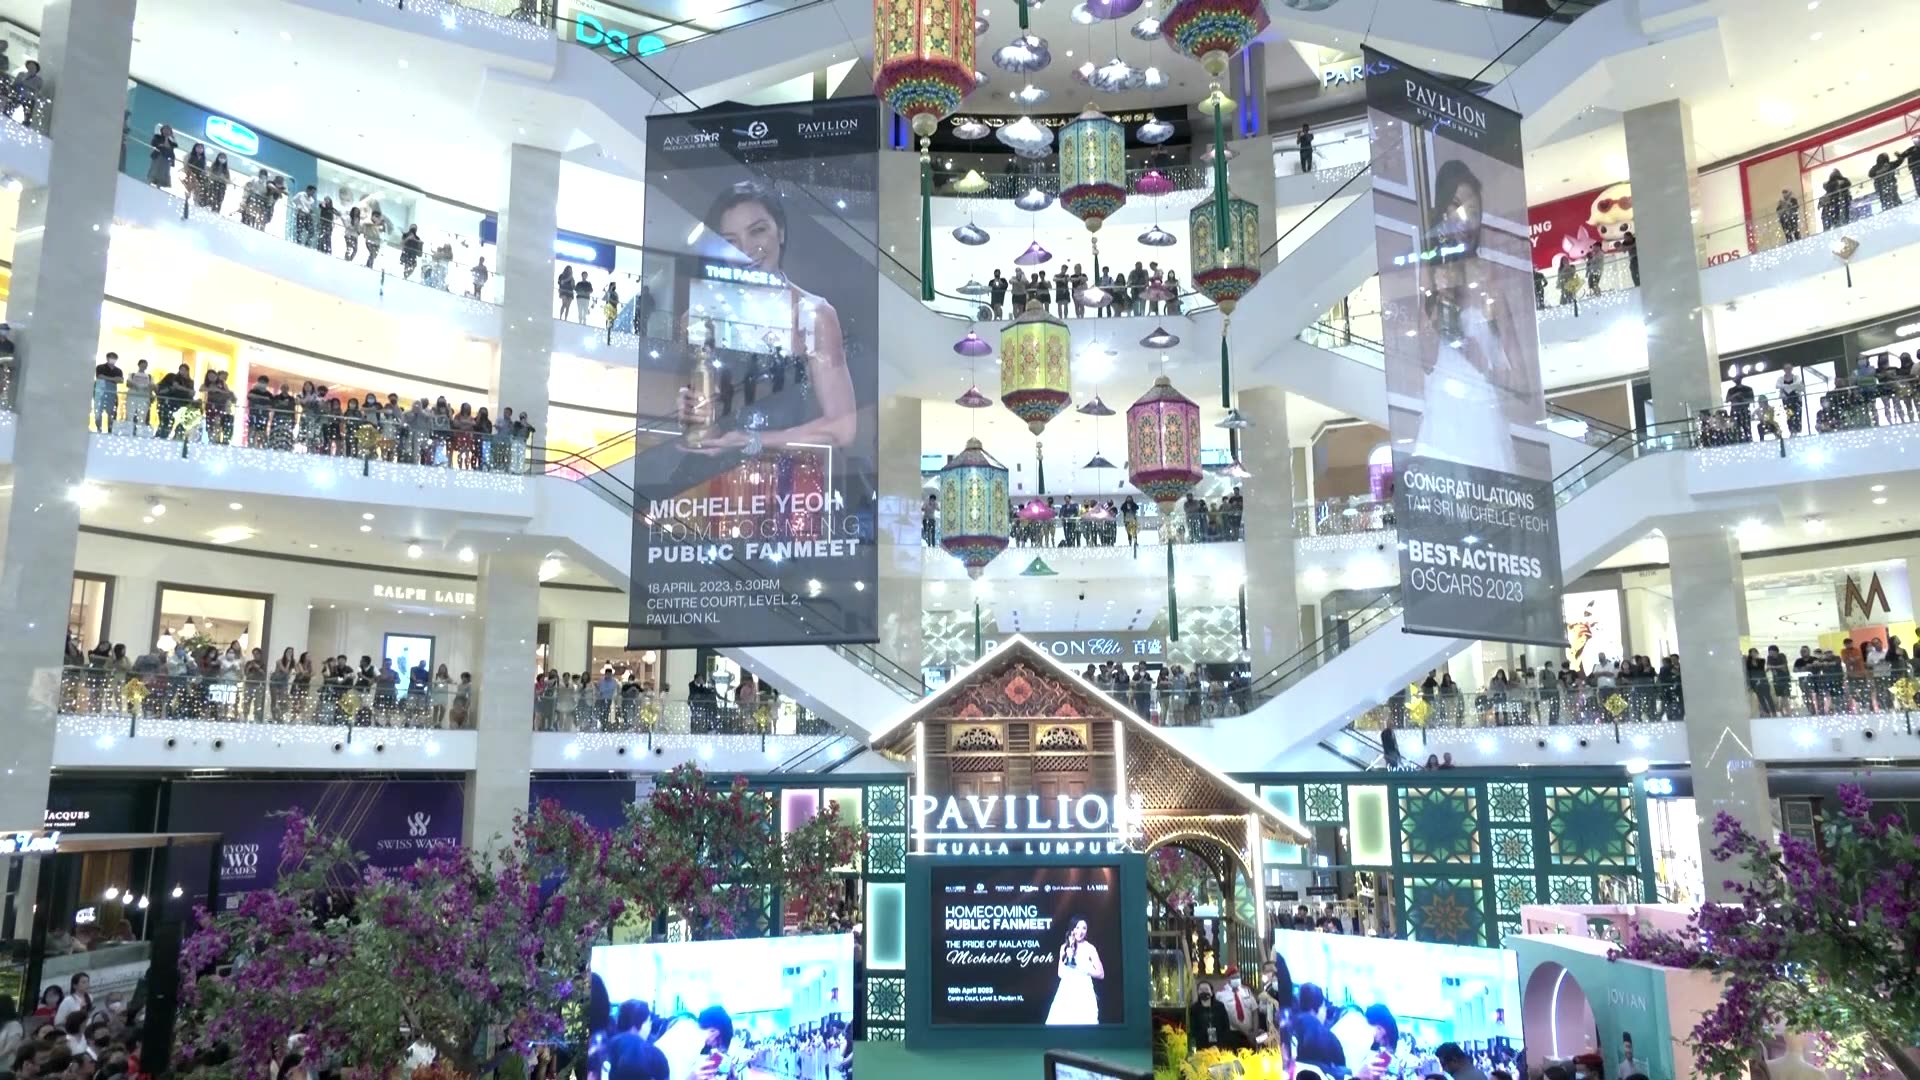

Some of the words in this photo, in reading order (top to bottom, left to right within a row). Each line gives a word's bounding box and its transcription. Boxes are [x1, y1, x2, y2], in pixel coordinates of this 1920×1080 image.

[1323, 60, 1398, 88] PARKS
[1406, 79, 1487, 129] PAVILION
[798, 119, 859, 133] PAVILION
[1529, 220, 1552, 236] ING
[1707, 249, 1741, 268] KIDS
[1403, 470, 1535, 510] CONGRATULATIONS
[650, 496, 766, 519] MICHELLE
[775, 492, 841, 514] YEOH
[1406, 494, 1431, 512] TAN
[1434, 499, 1454, 517] SRI
[1456, 503, 1516, 528] MICHELLE
[1517, 514, 1549, 533] YEOH
[649, 515, 860, 542] HOMECOMING
[648, 544, 734, 563] PUBLIC
[745, 539, 860, 560] FANMEET
[1409, 539, 1459, 567] BEST
[1462, 547, 1542, 578] ACTRESS
[373, 584, 427, 600] RALPH
[435, 590, 475, 605] LAUR
[648, 583, 660, 594] 18
[662, 582, 697, 593] APRIL
[735, 579, 780, 591] 5.30PM
[1411, 567, 1484, 598] OSCARS
[1486, 577, 1524, 603] 2023
[647, 597, 698, 609] CENTRE
[700, 595, 746, 608] COURT,
[749, 594, 789, 606] LEVEL
[646, 612, 702, 625] PAVILION
[704, 612, 721, 624] KL
[377, 839, 412, 850] SWISS
[936, 841, 1010, 856] KUALA
[1025, 841, 1117, 856] LUMPUR
[945, 905, 1038, 918] HOMECOMING
[945, 919, 991, 931] PUBLIC
[993, 918, 1053, 931] FANMEET
[946, 940, 961, 949] THE
[962, 940, 986, 949] PRIDE
[986, 940, 998, 949] OF
[999, 940, 1041, 949] MALAYSIA
[945, 949, 1012, 966] Michelle
[1016, 949, 1055, 968] Yeoh
[962, 986, 977, 995] April
